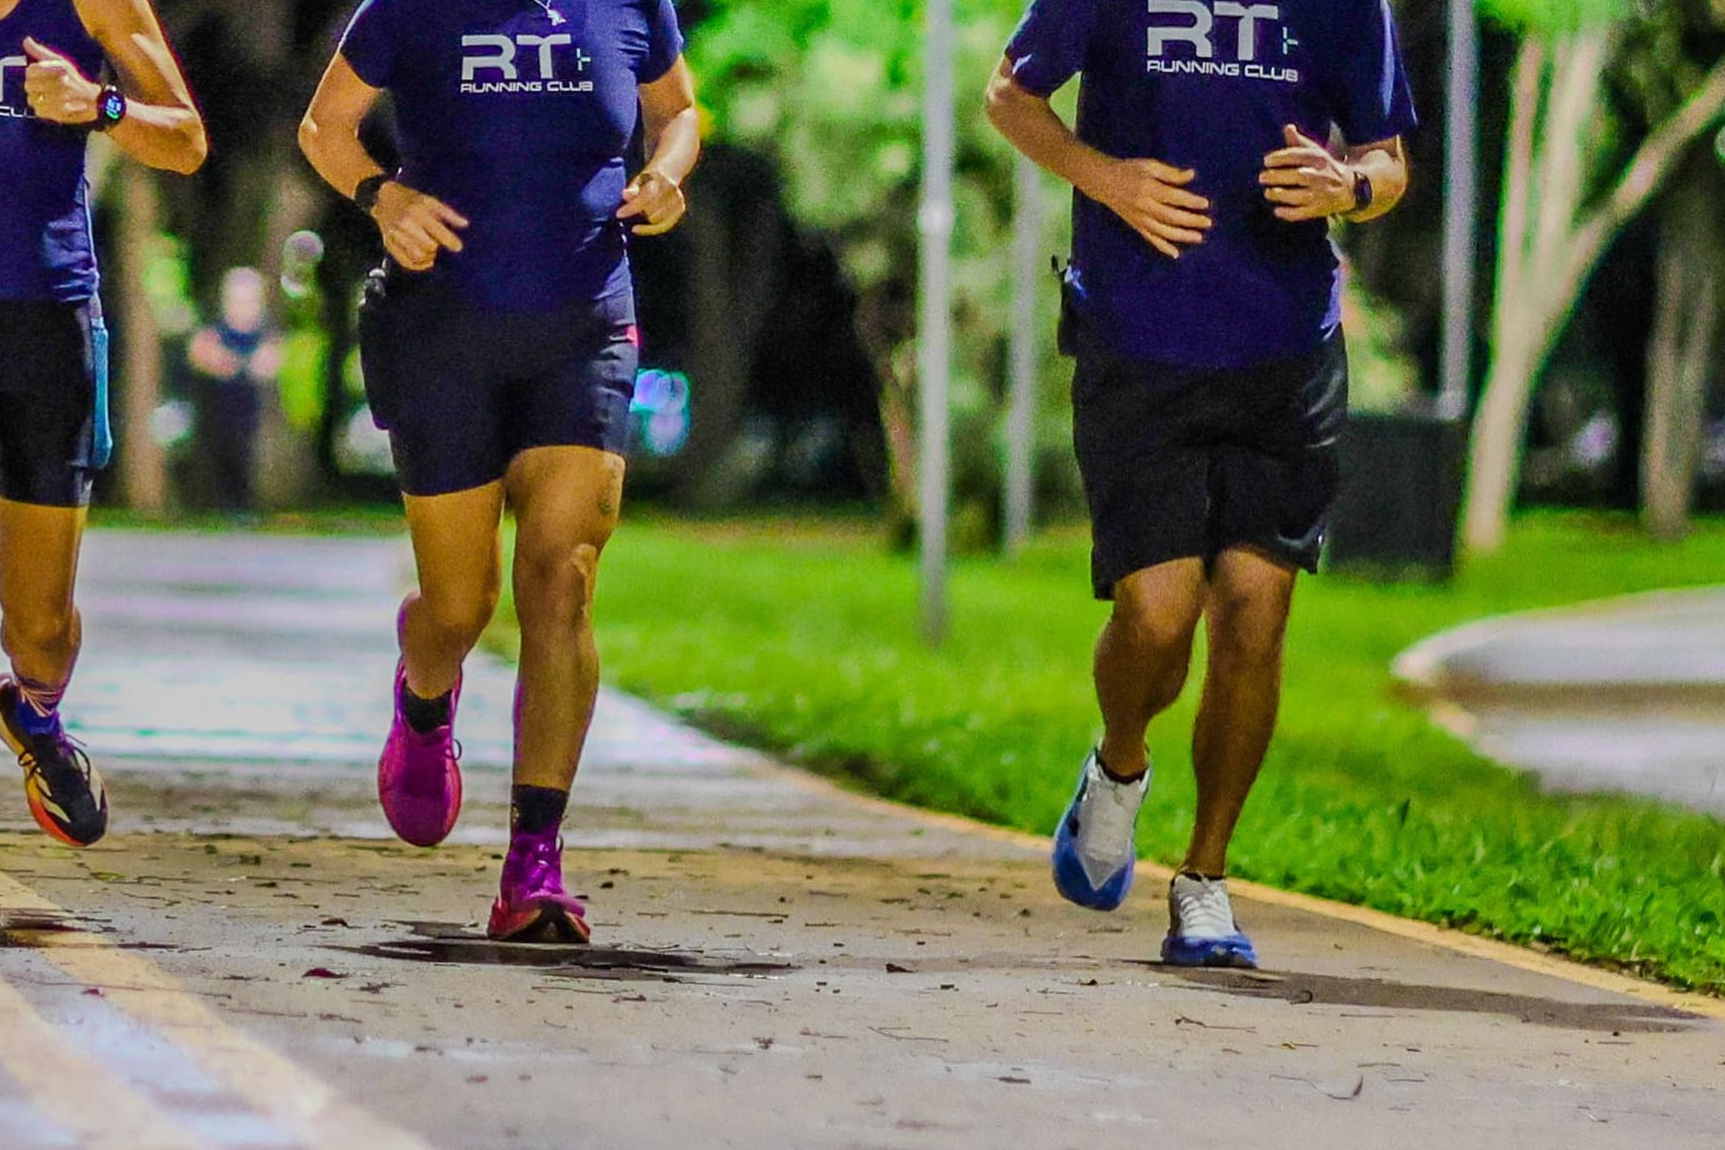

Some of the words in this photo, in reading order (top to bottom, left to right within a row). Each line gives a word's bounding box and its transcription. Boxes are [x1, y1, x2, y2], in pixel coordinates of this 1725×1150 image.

[461, 33, 572, 81] RT
[1146, 60, 1240, 77] RUNNING
[1244, 64, 1299, 82] CLUB
[460, 81, 542, 93] RUNNING
[546, 81, 594, 92] CLUB
